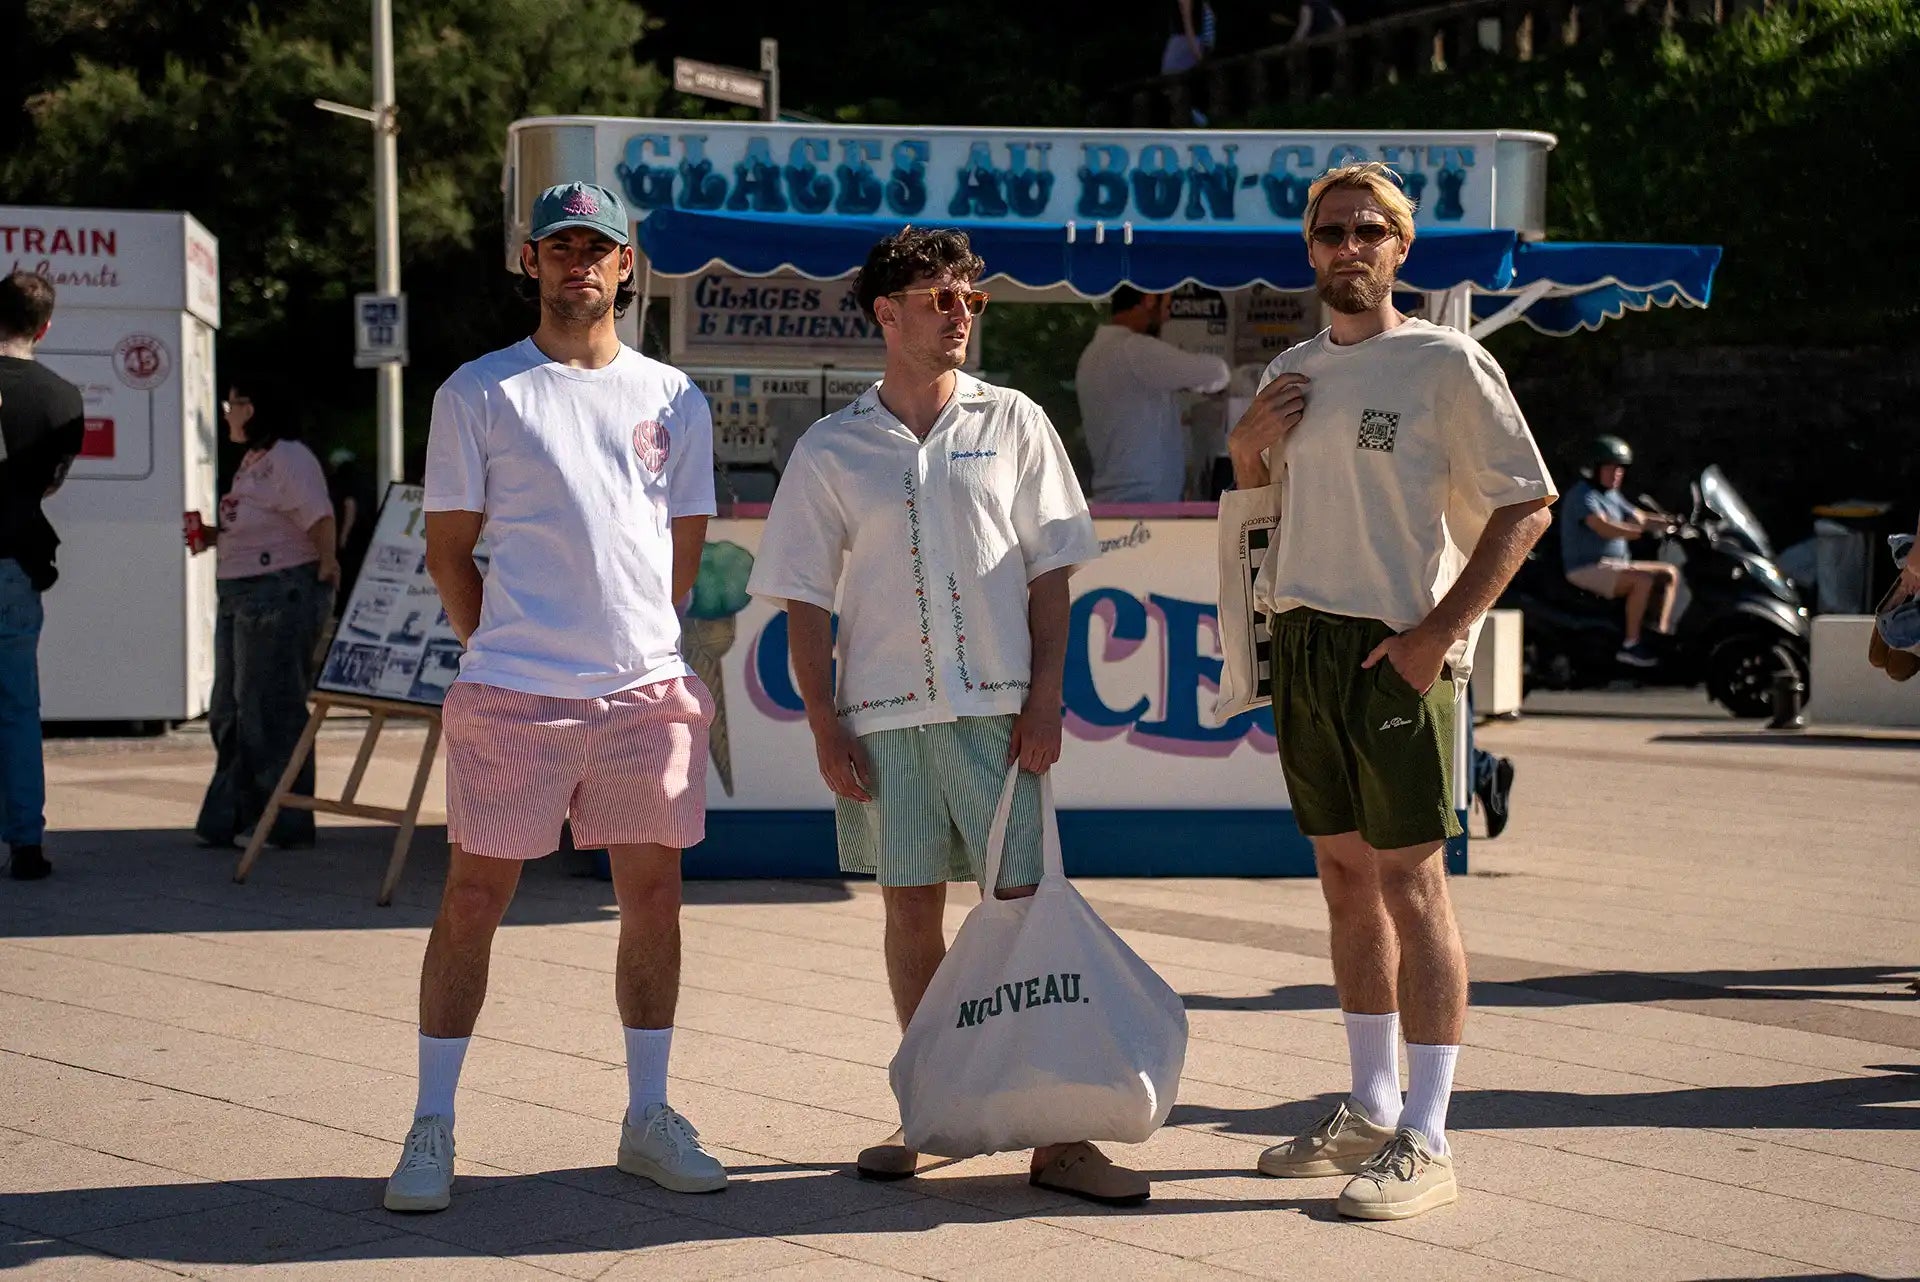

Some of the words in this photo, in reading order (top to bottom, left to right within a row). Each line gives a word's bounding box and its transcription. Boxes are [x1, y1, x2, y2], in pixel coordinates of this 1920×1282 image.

[615, 133, 931, 216] GLACES
[947, 140, 1056, 218] AU
[0, 226, 117, 256] TRAIN
[695, 275, 822, 311] GLACES
[762, 379, 809, 395] FRAISE
